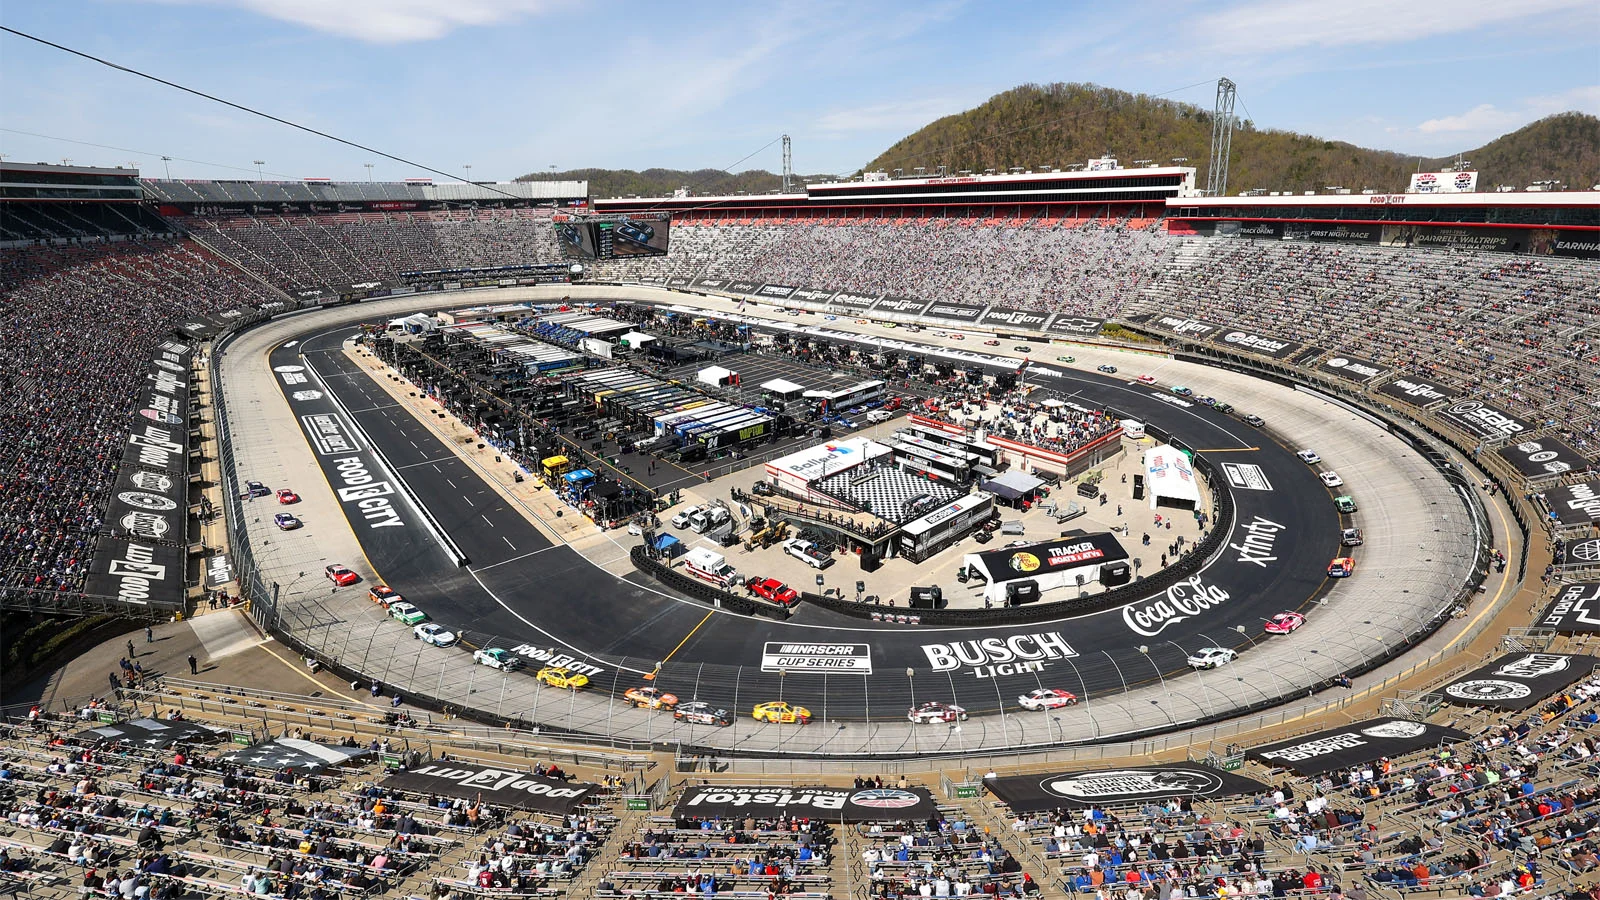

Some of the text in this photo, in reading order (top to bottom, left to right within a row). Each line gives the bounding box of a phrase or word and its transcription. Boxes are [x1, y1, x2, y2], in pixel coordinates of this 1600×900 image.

[1393, 195, 1405, 203] CITY
[1418, 235, 1507, 245] DARRELL WALTRIP'S
[879, 300, 925, 311] FOOD CITY
[987, 311, 1010, 322] FOOD
[1024, 315, 1046, 325] CITY
[1158, 316, 1213, 333] FOOD CITY
[1052, 323, 1096, 334] CHEVROLET
[1245, 334, 1289, 350] Bristol
[1392, 379, 1446, 399] FOOD CITY
[1471, 407, 1525, 436] state
[739, 424, 764, 441] RAPTOR
[707, 437, 719, 448] 24
[790, 453, 838, 472] Ballad
[333, 457, 405, 529] FOOD CITY
[1048, 542, 1095, 557] TRACKER
[1230, 515, 1287, 568] xfinity
[1051, 554, 1077, 565] BOATS
[1081, 552, 1101, 560] ATVs
[118, 543, 154, 605] FOOD CITY
[1543, 585, 1586, 626] CHEVROLET
[797, 644, 854, 655] NASCAR
[920, 631, 1080, 672] BUSCH
[510, 643, 604, 677] FOOD CITY
[776, 657, 856, 668] CUP SERIES
[973, 660, 1045, 679] LIGHT
[1281, 738, 1368, 762] TRACKER
[409, 765, 588, 798] FOOD CITY
[1082, 784, 1159, 795] SPEEDWAY
[699, 787, 850, 797] Motor Speedway
[687, 793, 848, 810] Bristol
